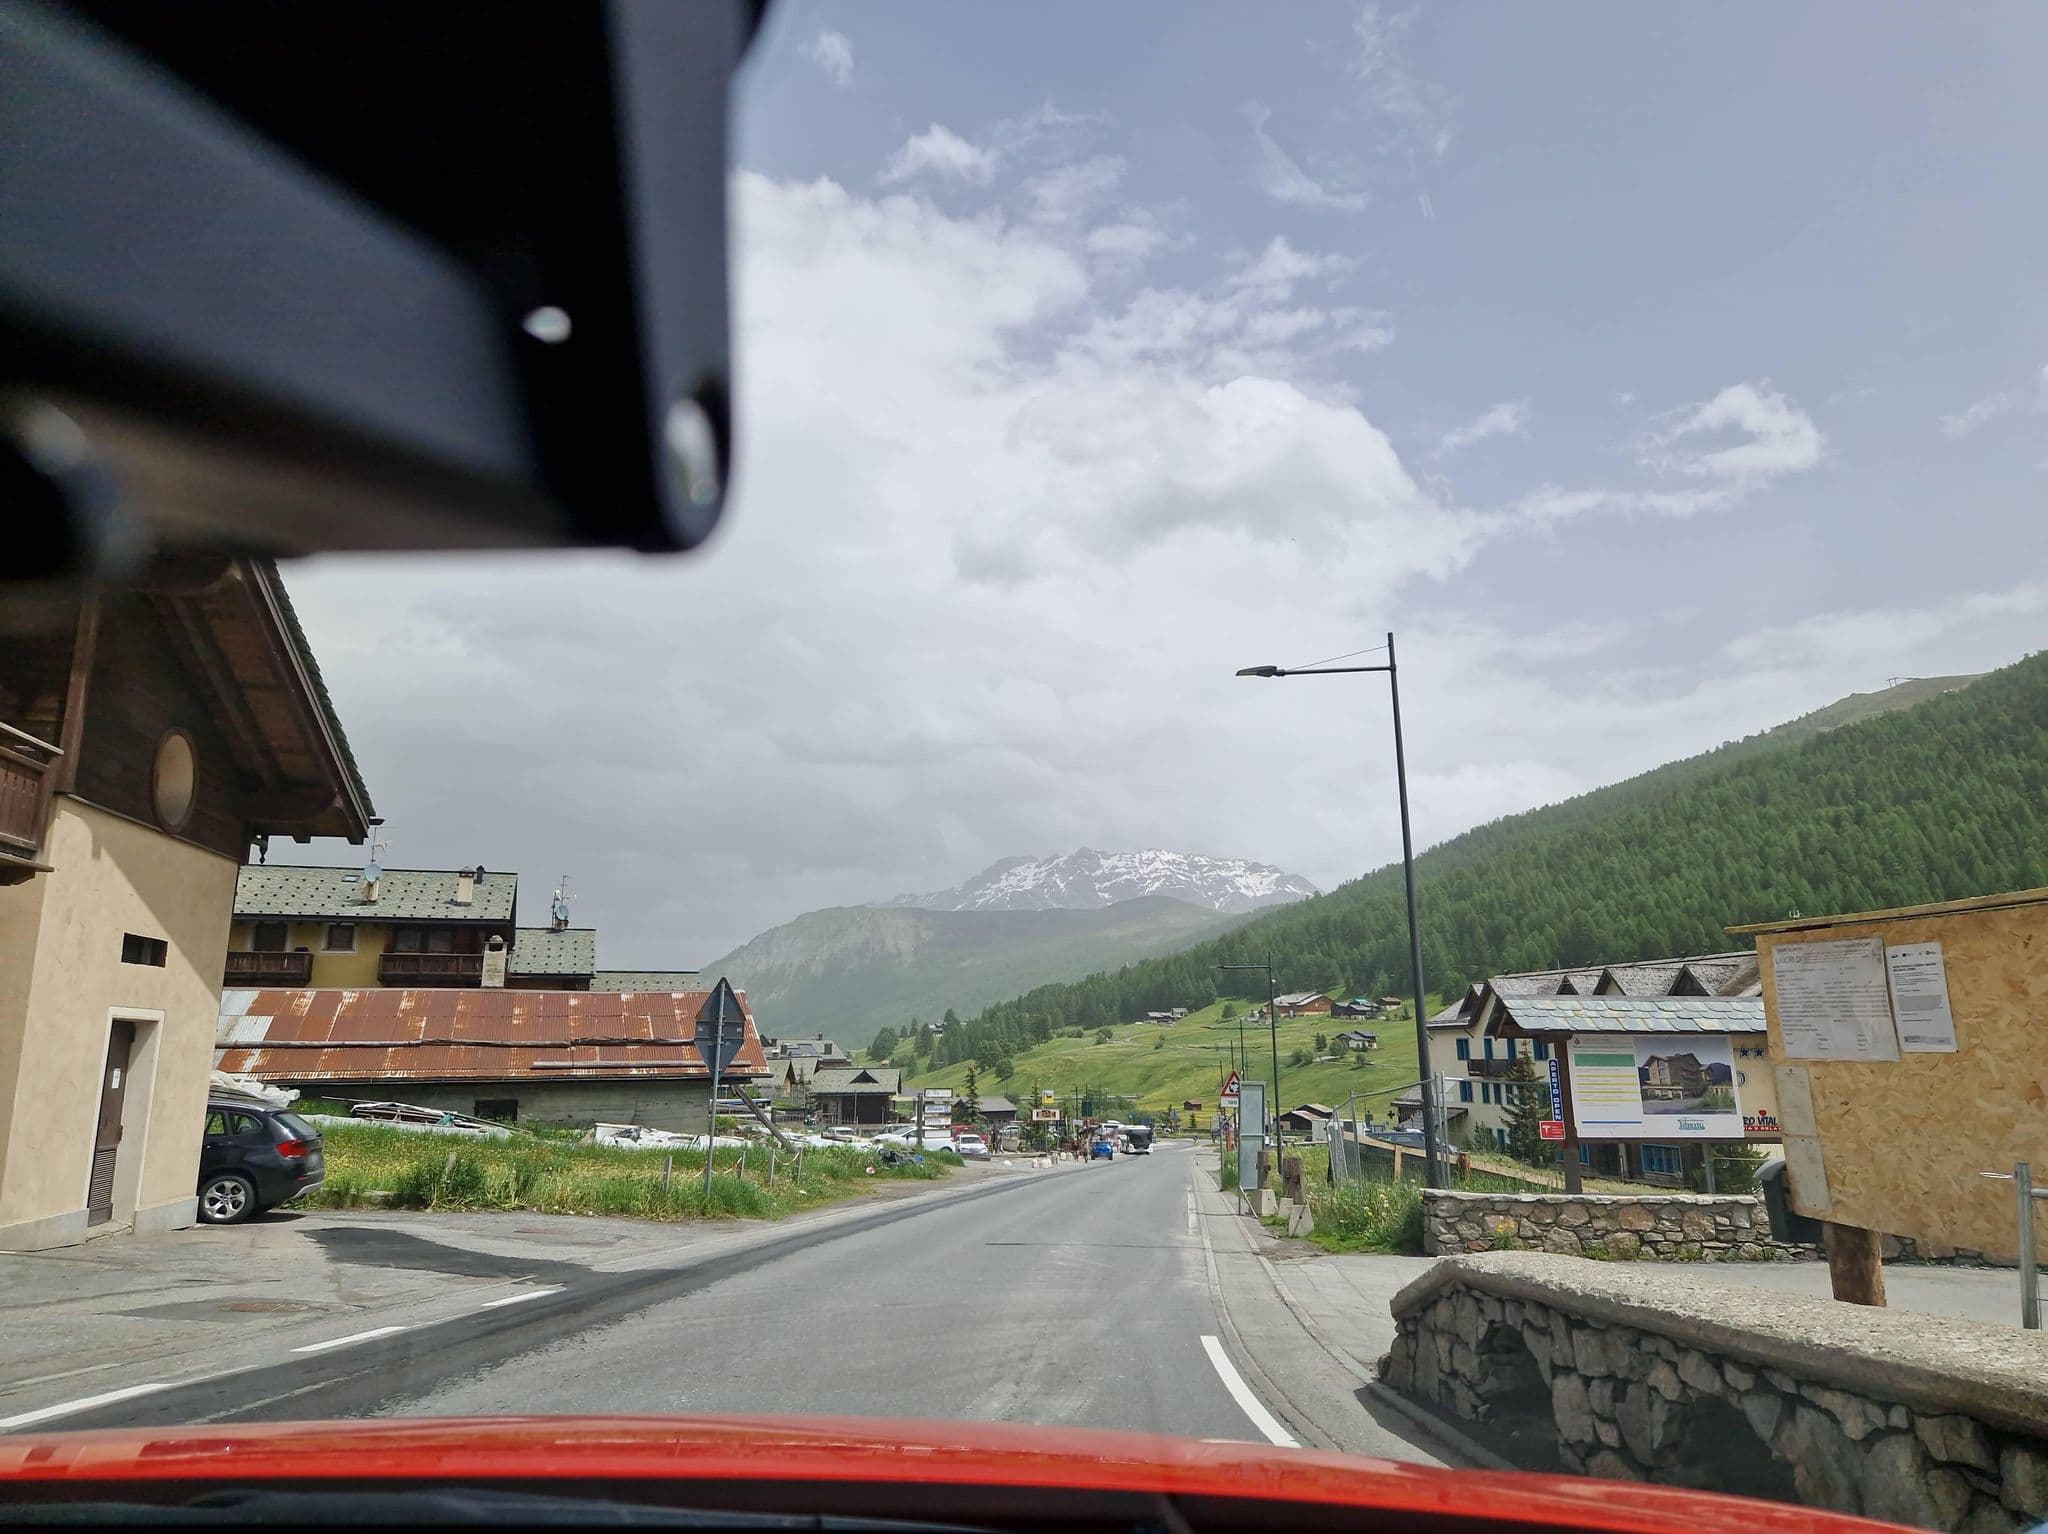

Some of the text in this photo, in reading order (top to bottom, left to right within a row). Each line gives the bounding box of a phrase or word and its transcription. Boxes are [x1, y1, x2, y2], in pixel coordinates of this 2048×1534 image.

[1550, 1061, 1559, 1094] APERTO
[1553, 1097, 1562, 1121] OPEN
[1758, 1116, 1778, 1126] VITAL
